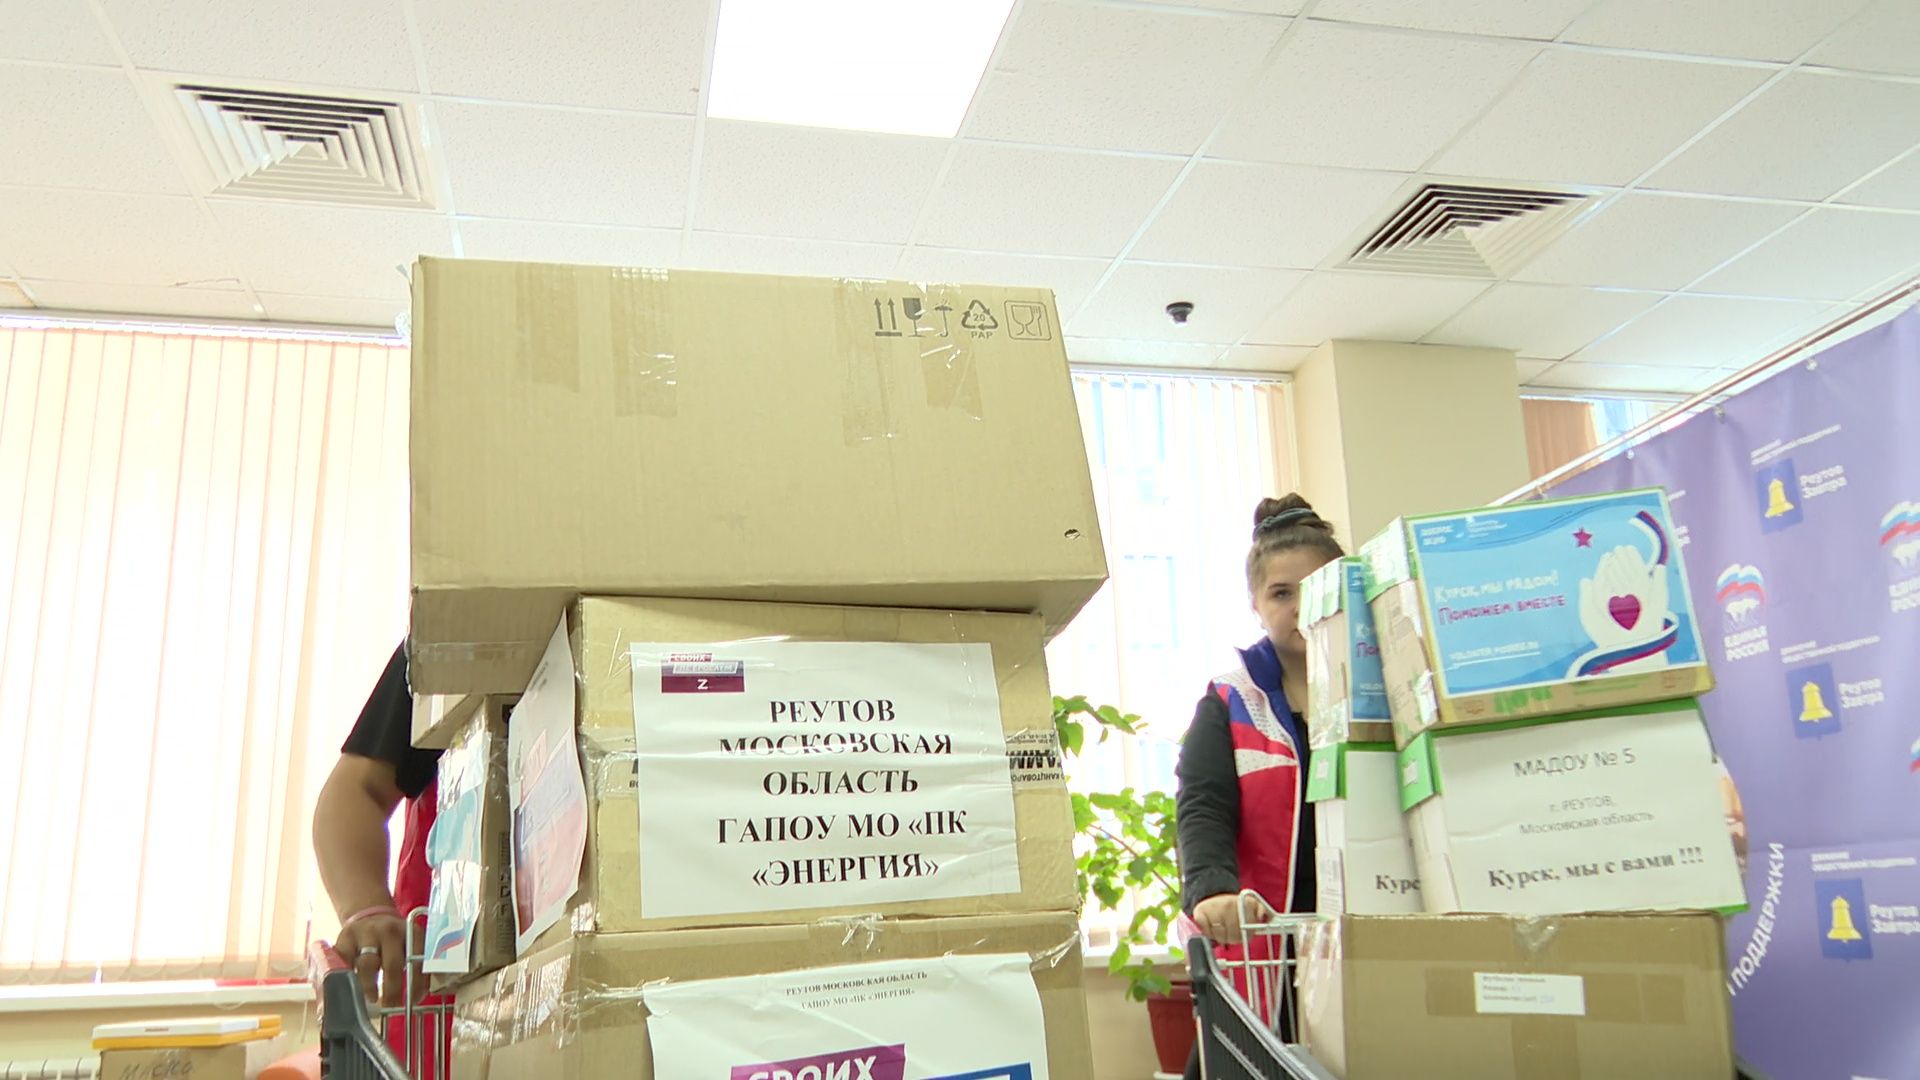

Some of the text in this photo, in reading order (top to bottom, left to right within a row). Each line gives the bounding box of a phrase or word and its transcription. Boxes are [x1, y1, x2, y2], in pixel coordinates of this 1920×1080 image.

[973, 313, 985, 321] 20
[971, 331, 993, 339] PAP
[697, 679, 709, 690] Z
[769, 699, 896, 724] РЕУТОВ
[719, 732, 952, 756] МОСКОВСКАЯ
[1513, 747, 1636, 777] МАДОУ № 5
[763, 770, 919, 796] ОБЛАСТЬ
[1011, 772, 1060, 782] КАНЦТОВАРО
[717, 810, 967, 844] ГАПОУ МО «ПК
[1519, 812, 1655, 834] Московская область
[752, 853, 939, 887] «ЭНЕРГИЯ»
[1488, 846, 1704, 890] Курск, мы с вами !!!
[1375, 874, 1421, 895] Курс
[1731, 842, 1785, 989] ПОДДЕРЖКИ
[786, 971, 928, 996] РЕУТОВ МОСКОВСКАЯ ОБЛАСТЬ
[801, 999, 831, 1010] ГАПОУ
[833, 995, 848, 1005] МО
